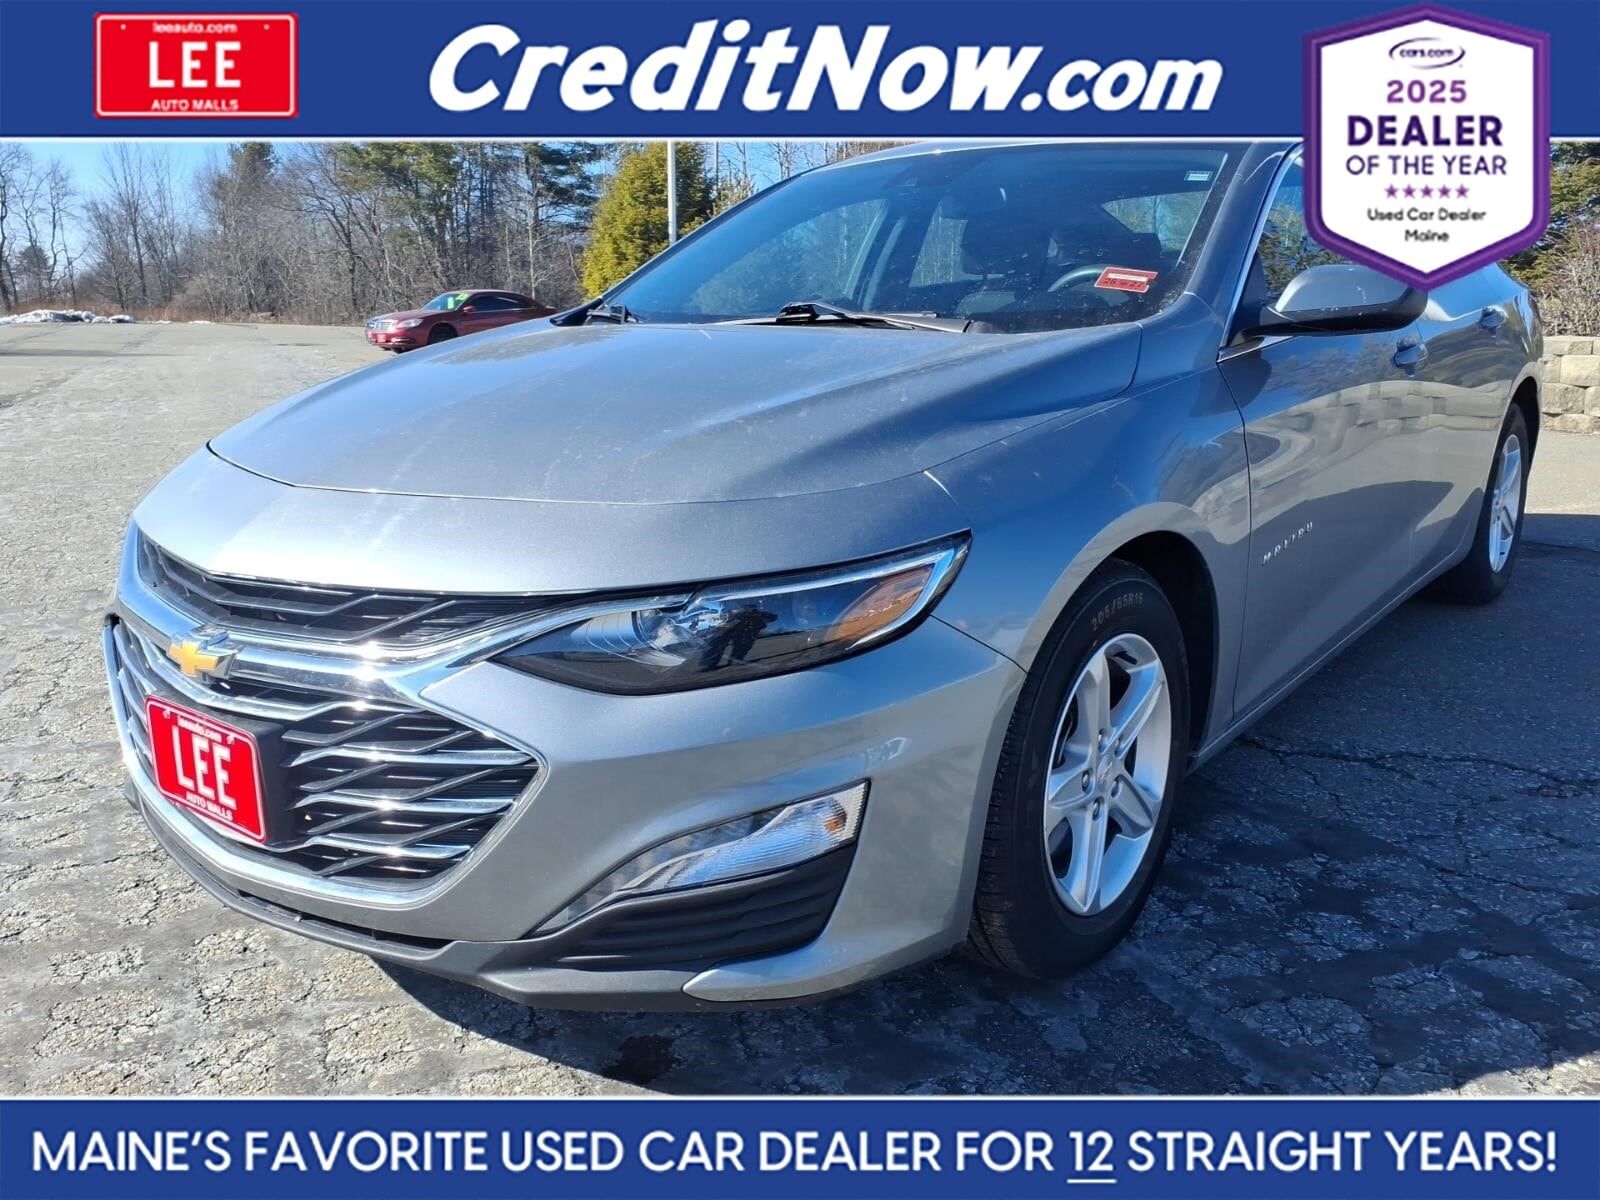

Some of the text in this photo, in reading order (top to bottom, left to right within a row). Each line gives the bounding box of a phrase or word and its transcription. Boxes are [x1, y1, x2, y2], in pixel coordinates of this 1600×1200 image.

[172, 725, 237, 811] LEE
[186, 791, 233, 821] AUTO MALLS
